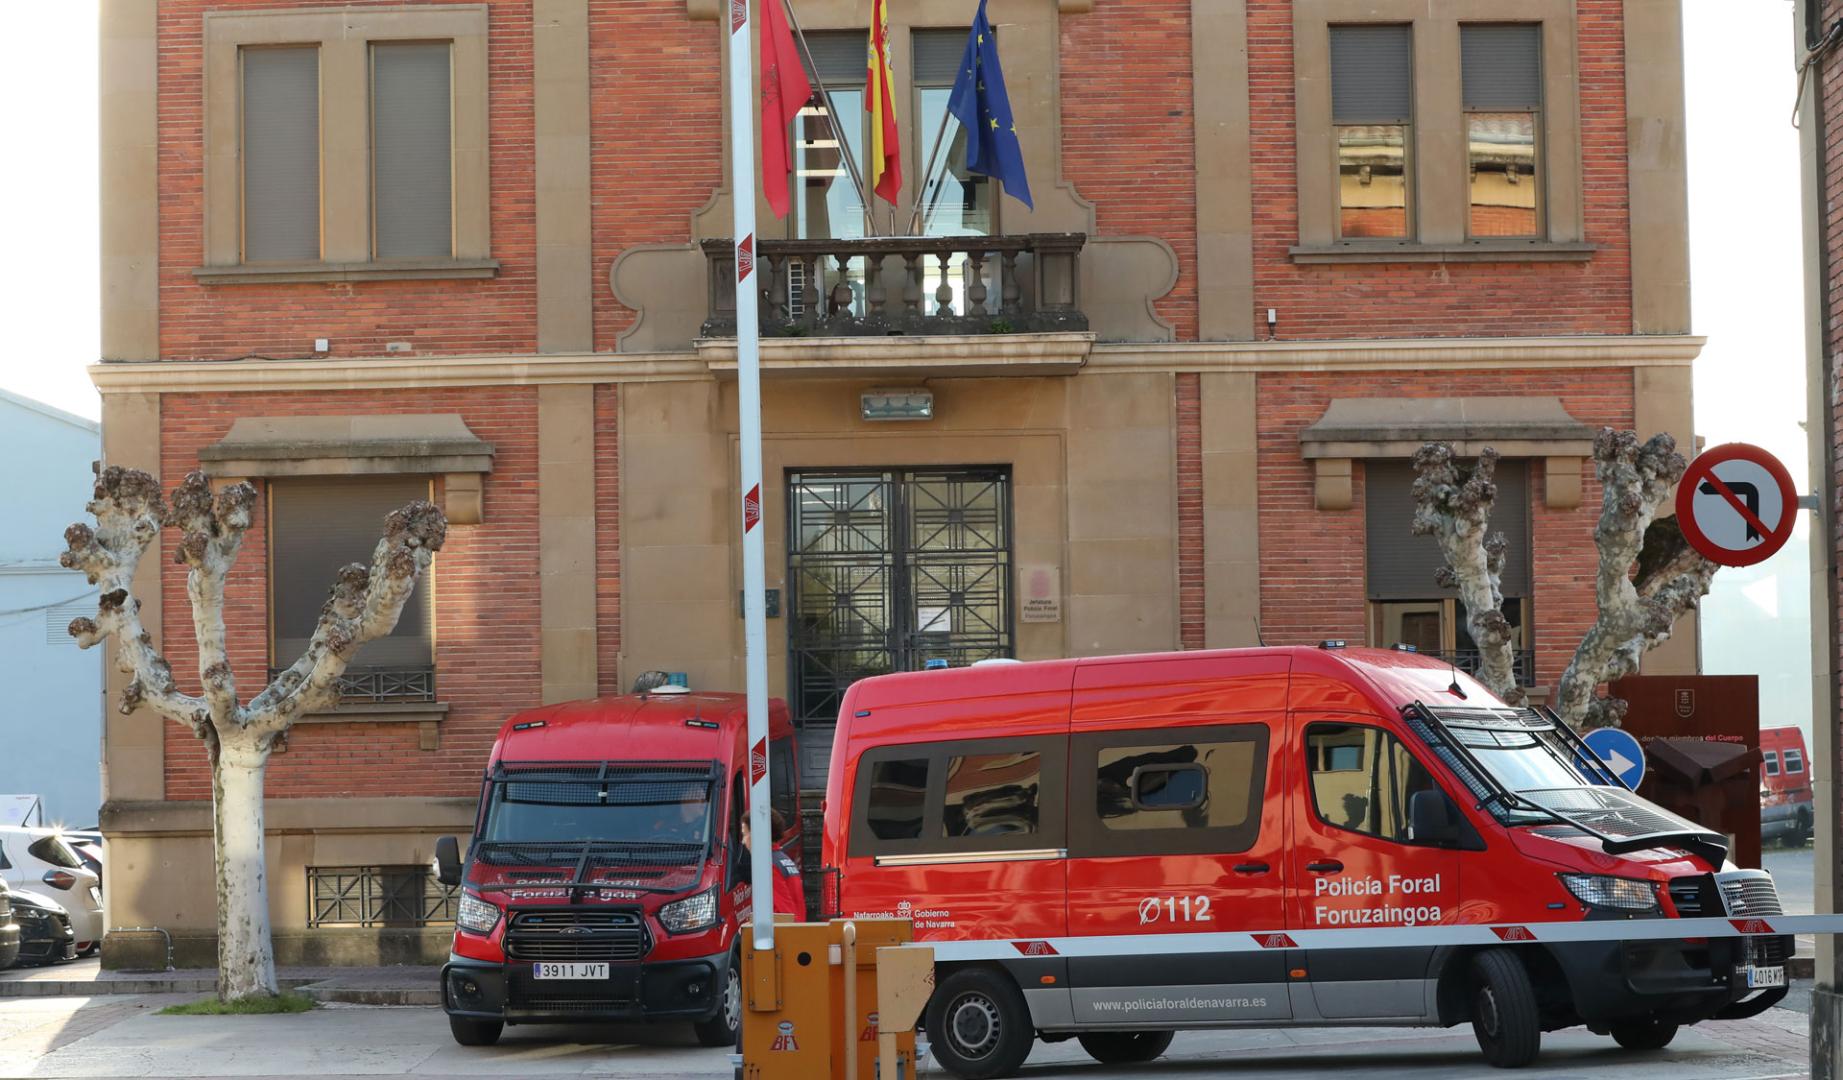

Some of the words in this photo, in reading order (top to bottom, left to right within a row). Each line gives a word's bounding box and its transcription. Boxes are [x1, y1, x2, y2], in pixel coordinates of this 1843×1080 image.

[1315, 875, 1382, 897] Policía
[1389, 873, 1440, 894] Foral
[853, 911, 894, 919] Nafarroako
[914, 909, 950, 918] Gobierno
[1164, 895, 1212, 922] 112
[1315, 904, 1441, 926] Foruzaingoa
[926, 920, 955, 928] Navarra
[543, 965, 575, 977] 3911
[581, 965, 605, 977] JVT
[1093, 997, 1267, 1013] www.policiaforaldenavarra.es
[860, 1026, 879, 1041] BF
